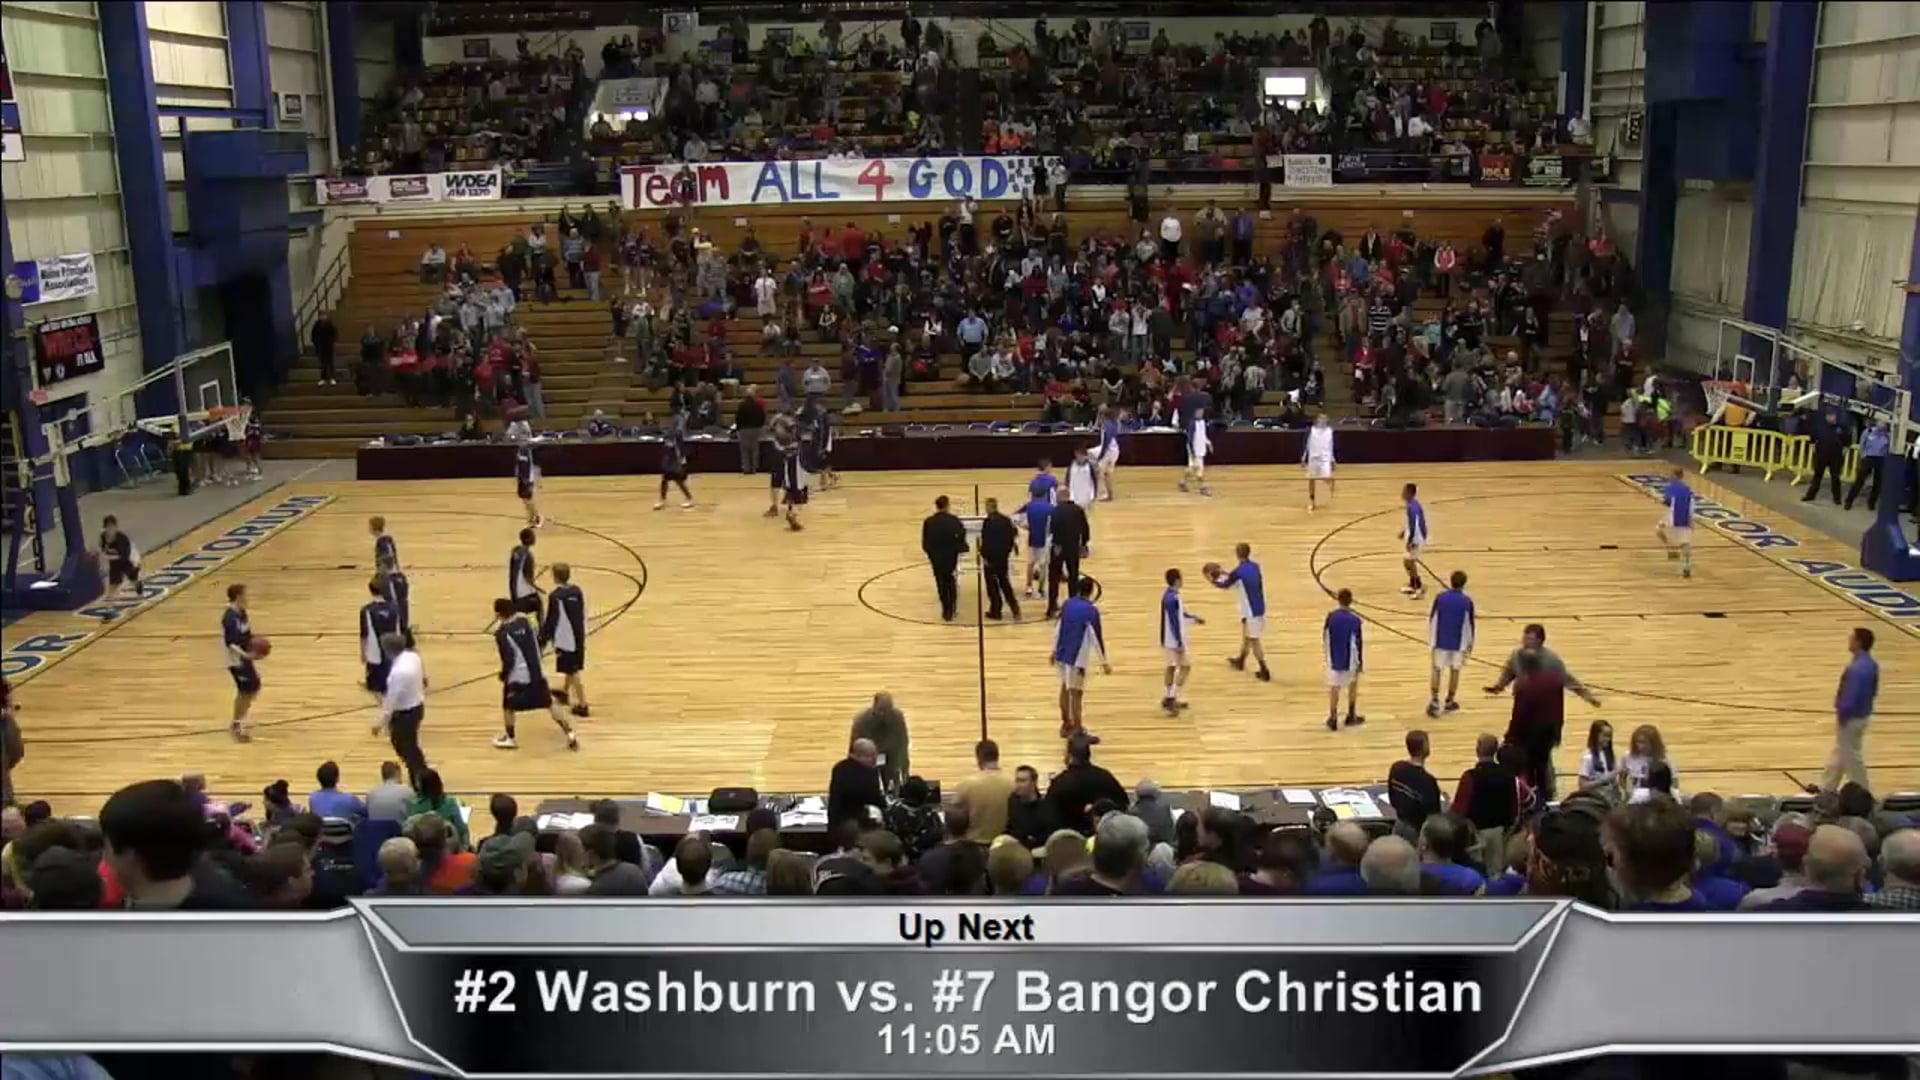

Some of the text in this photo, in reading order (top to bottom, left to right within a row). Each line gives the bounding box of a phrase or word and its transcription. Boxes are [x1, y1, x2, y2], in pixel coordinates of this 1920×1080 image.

[445, 174, 497, 188] WDEA
[621, 157, 1008, 208] Team ALL 4 GOD
[44, 278, 89, 292] Association
[1783, 558, 1920, 631] AUDI
